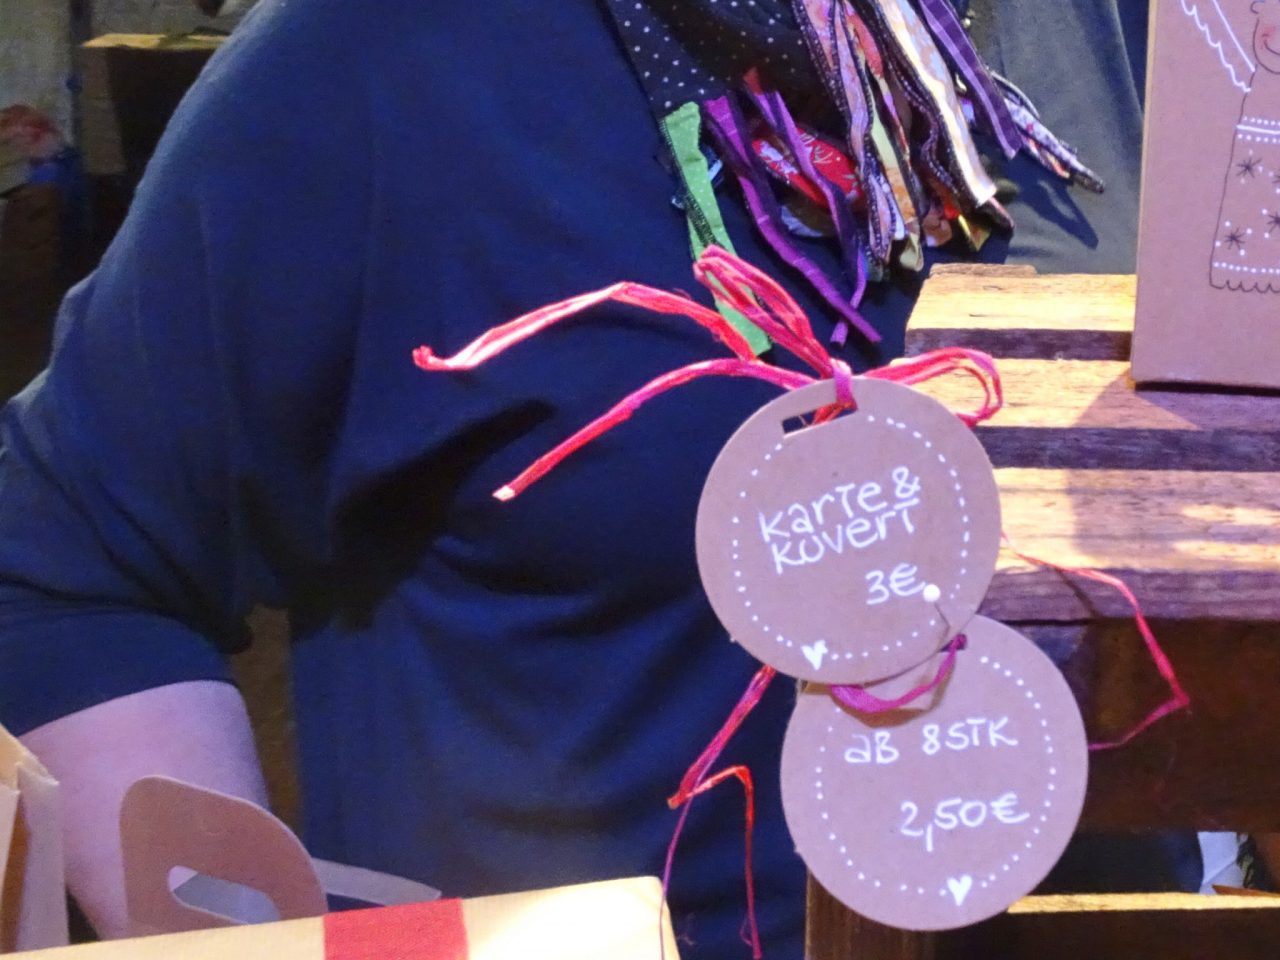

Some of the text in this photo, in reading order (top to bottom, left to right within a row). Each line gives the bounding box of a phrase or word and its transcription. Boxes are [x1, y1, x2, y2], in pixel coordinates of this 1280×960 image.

[892, 466, 921, 499] &
[865, 563, 926, 605] 3€
[900, 790, 1031, 853] 2,50€
